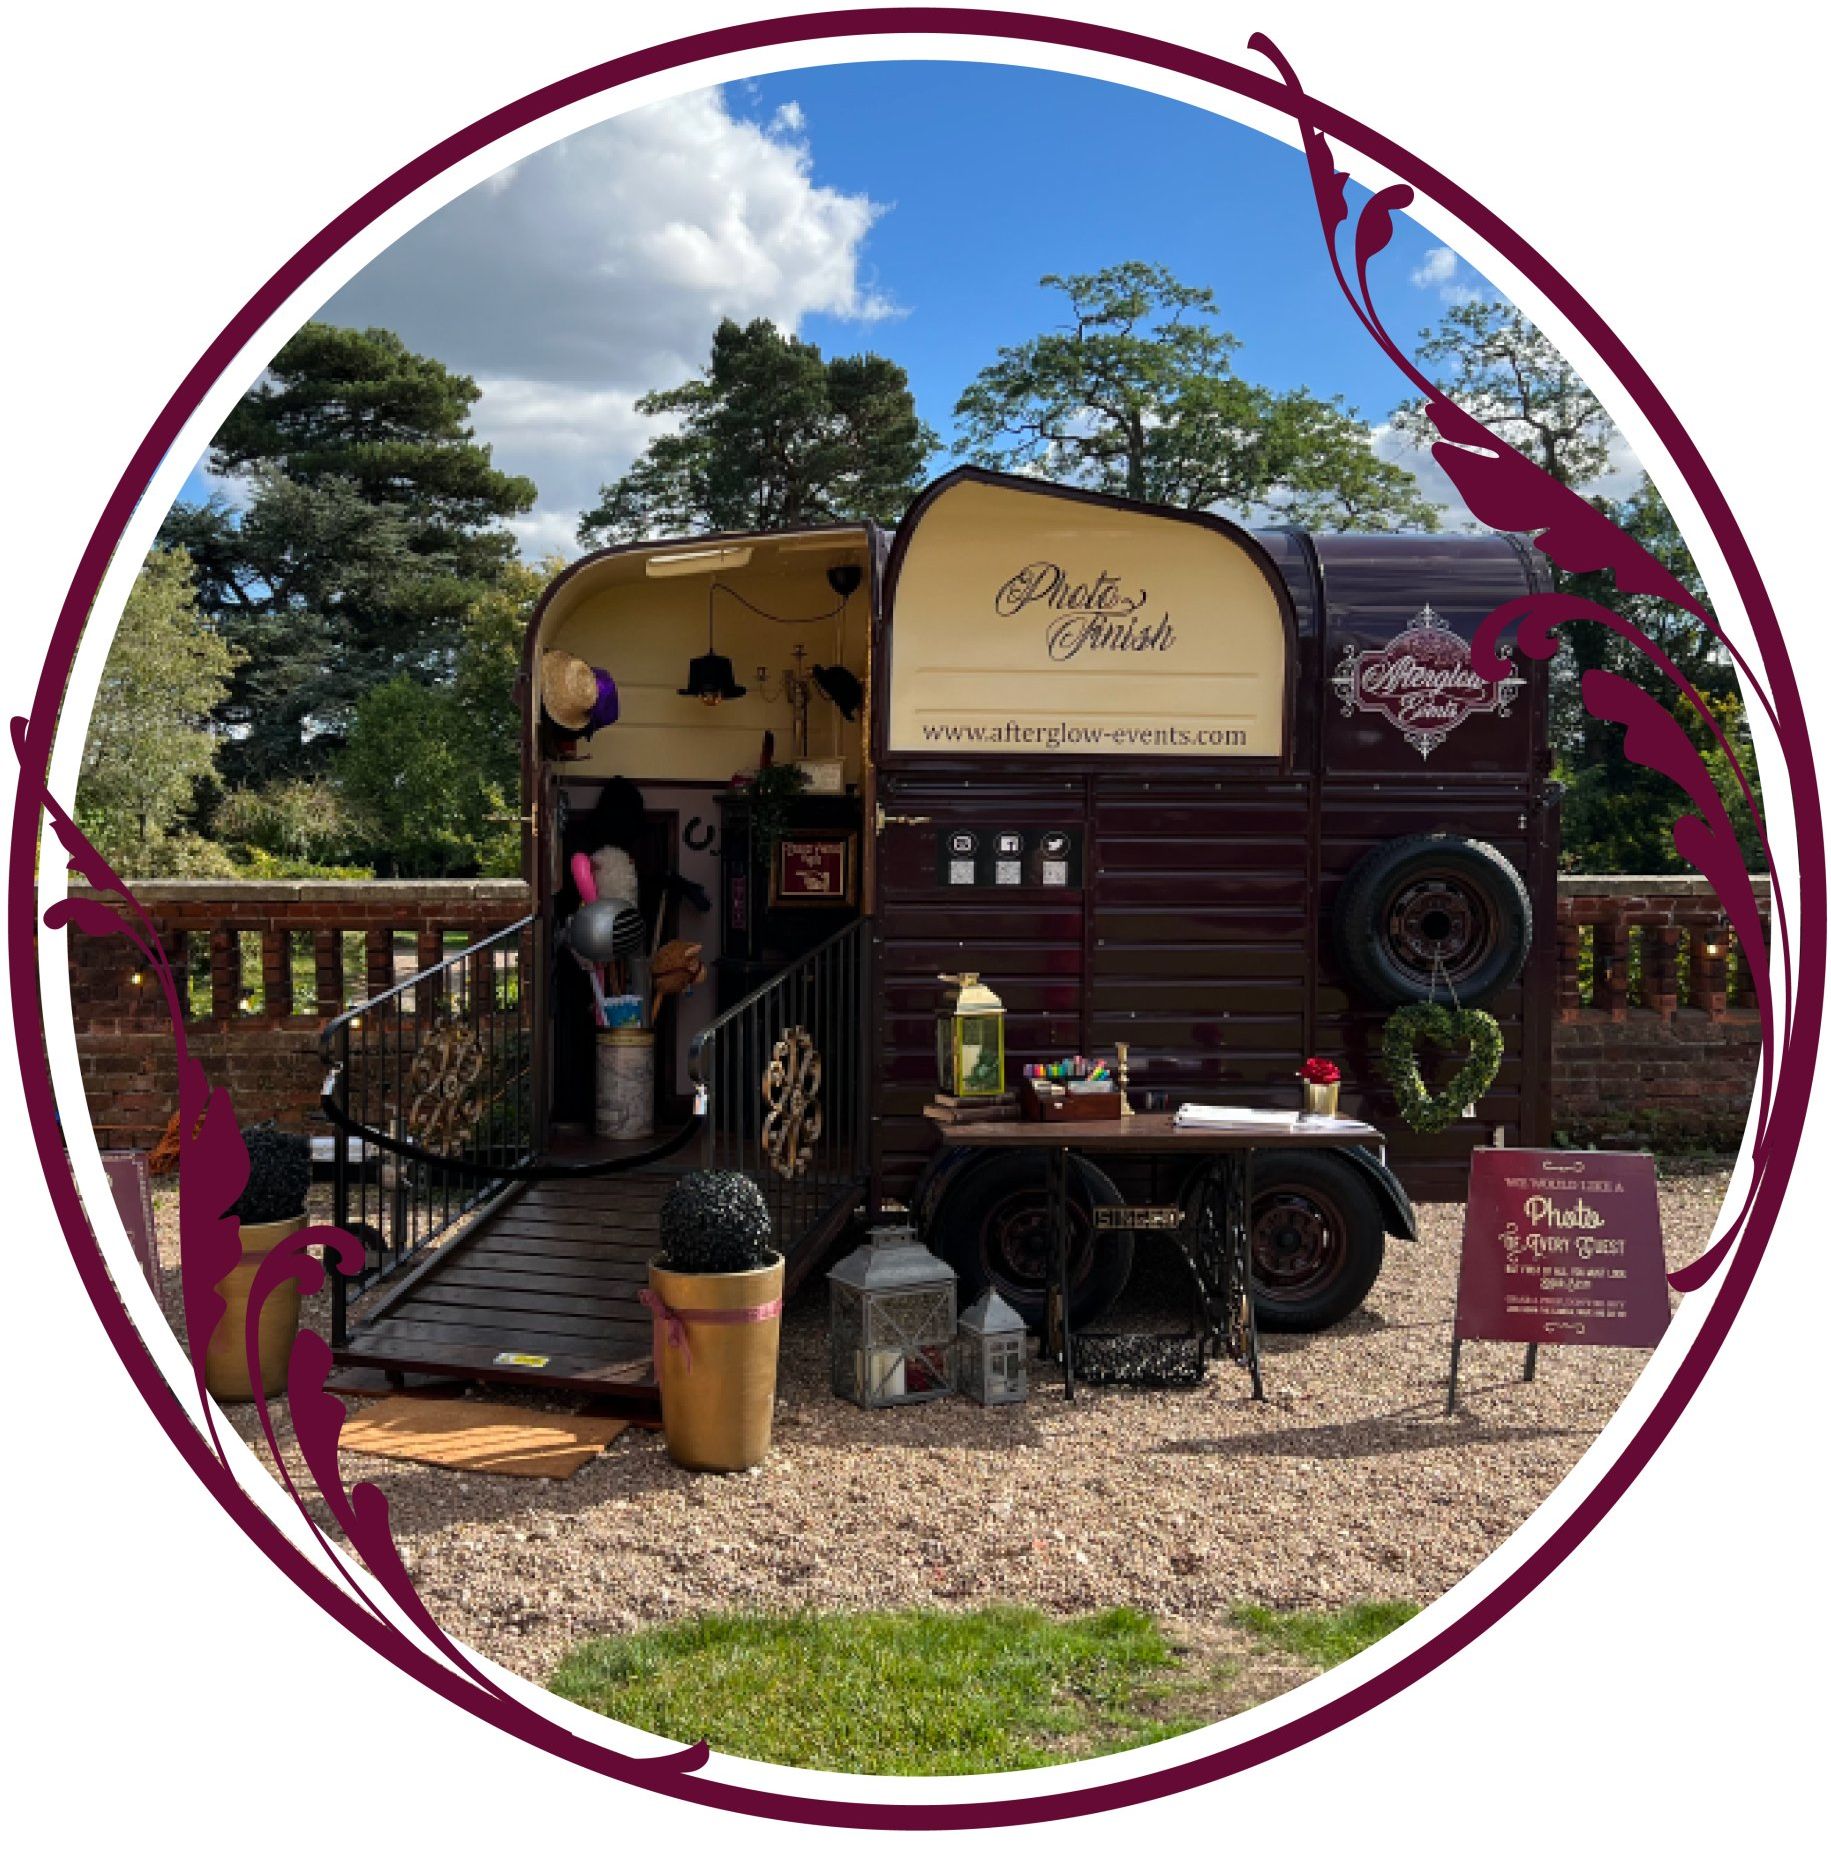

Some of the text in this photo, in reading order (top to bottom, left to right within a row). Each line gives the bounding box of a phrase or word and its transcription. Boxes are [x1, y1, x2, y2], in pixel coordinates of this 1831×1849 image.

[995, 561, 1147, 617] Photo
[1046, 611, 1178, 662] Finish
[922, 719, 1248, 748] www.afterglow-events.com
[1523, 1194, 1605, 1229] Photo
